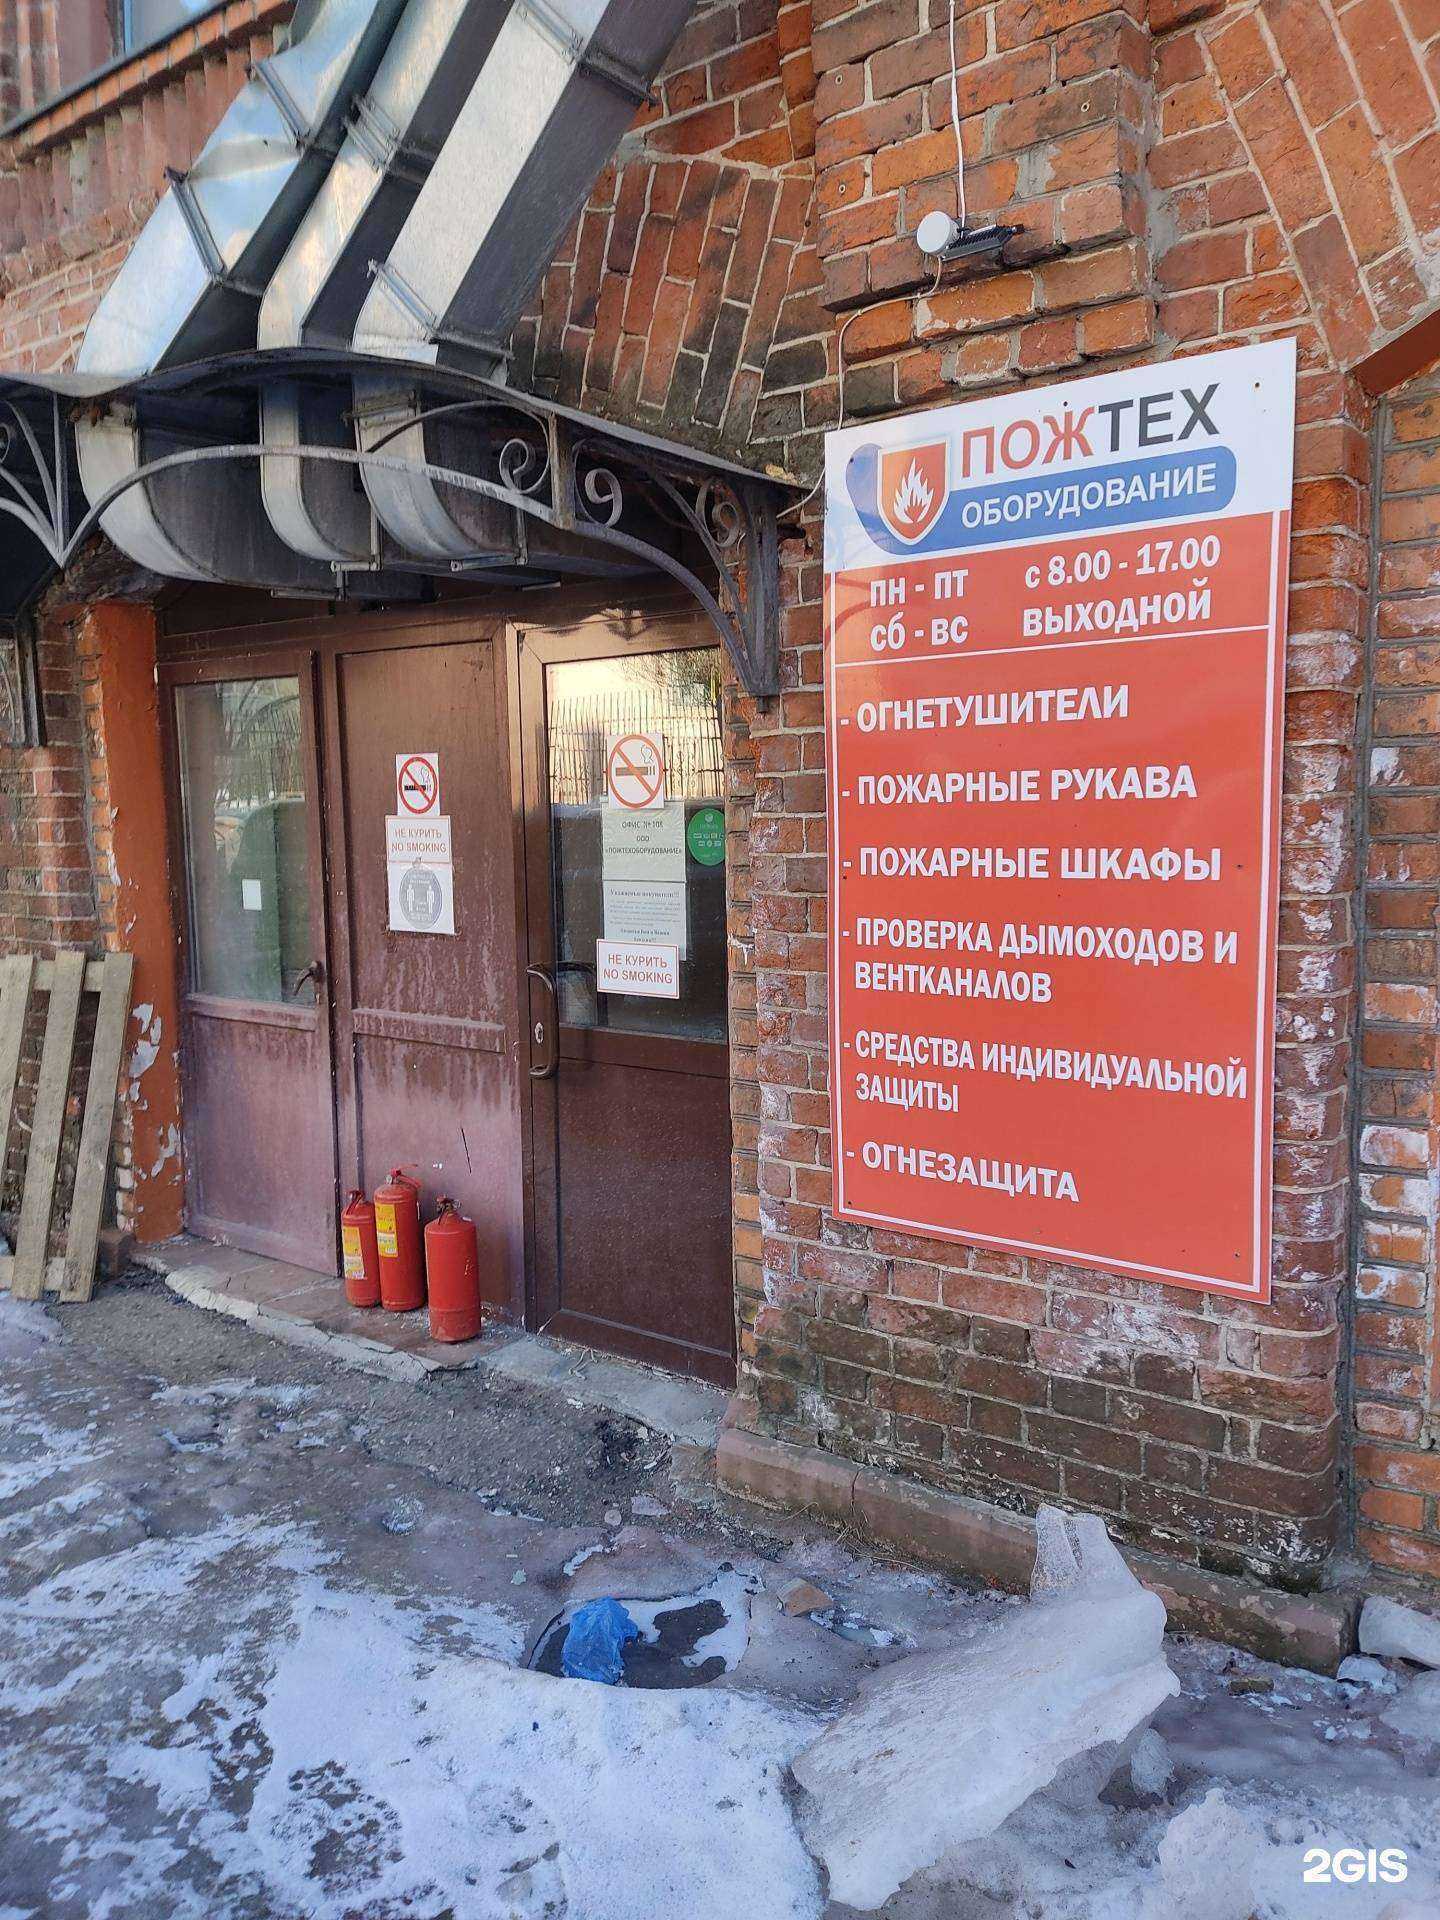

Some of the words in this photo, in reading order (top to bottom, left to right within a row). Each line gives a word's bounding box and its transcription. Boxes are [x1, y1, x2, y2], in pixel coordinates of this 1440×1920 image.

[961, 382, 1220, 478] ПОЖТЕХ
[961, 461, 1218, 530] ОБОРУДОВАНИЕ
[1047, 549, 1112, 586] 8.00
[1136, 534, 1221, 576] 17.00
[857, 684, 1129, 733] ОГНЕТУШИТЕЛИ
[857, 770, 1040, 805] ПОЖАРНЫЕ
[1050, 764, 1198, 801] РУКАВА
[391, 842, 404, 851] NO
[406, 843, 447, 853] SMOKING
[395, 828, 407, 838] НЕ
[408, 828, 442, 839] КУРИТЬ
[859, 847, 1049, 879] ПОЖАРНЫЕ
[1061, 846, 1221, 881] ШКАФЫ
[608, 953, 623, 966] НЕ
[625, 954, 668, 969] КУРИТЬ
[856, 917, 993, 953] ПРОВЕРКА
[998, 923, 1205, 966] ДЫМОХОДОВ
[1213, 931, 1238, 964] И
[603, 967, 619, 981] NO
[621, 969, 673, 985] SMOKING
[854, 961, 1053, 1004] ВЕНТКАНАЛОВ
[855, 1029, 976, 1070] СРЕДСТВА
[981, 1041, 1248, 1099] ИНДИВИДУАЛЬНОЙ
[855, 1072, 960, 1113] ЗАЩИТЫ
[861, 1140, 1080, 1203] ОГНЕЗАЩИТА
